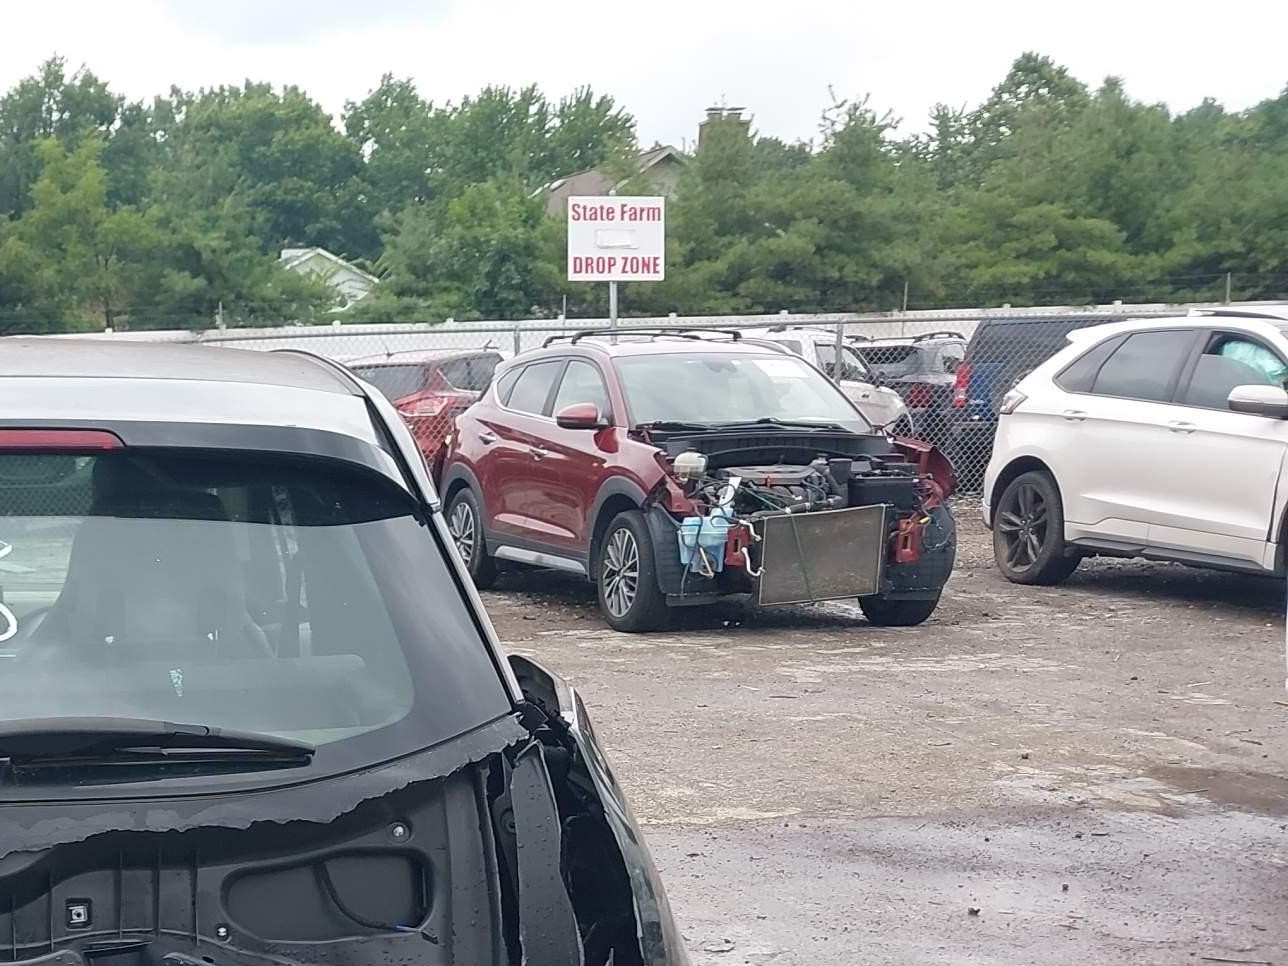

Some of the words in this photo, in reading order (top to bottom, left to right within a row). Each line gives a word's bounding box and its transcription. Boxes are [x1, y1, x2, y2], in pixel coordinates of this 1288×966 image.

[572, 203, 615, 222] State
[620, 203, 661, 222] Farm
[573, 256, 617, 274] DROP
[621, 256, 660, 274] ZONE
